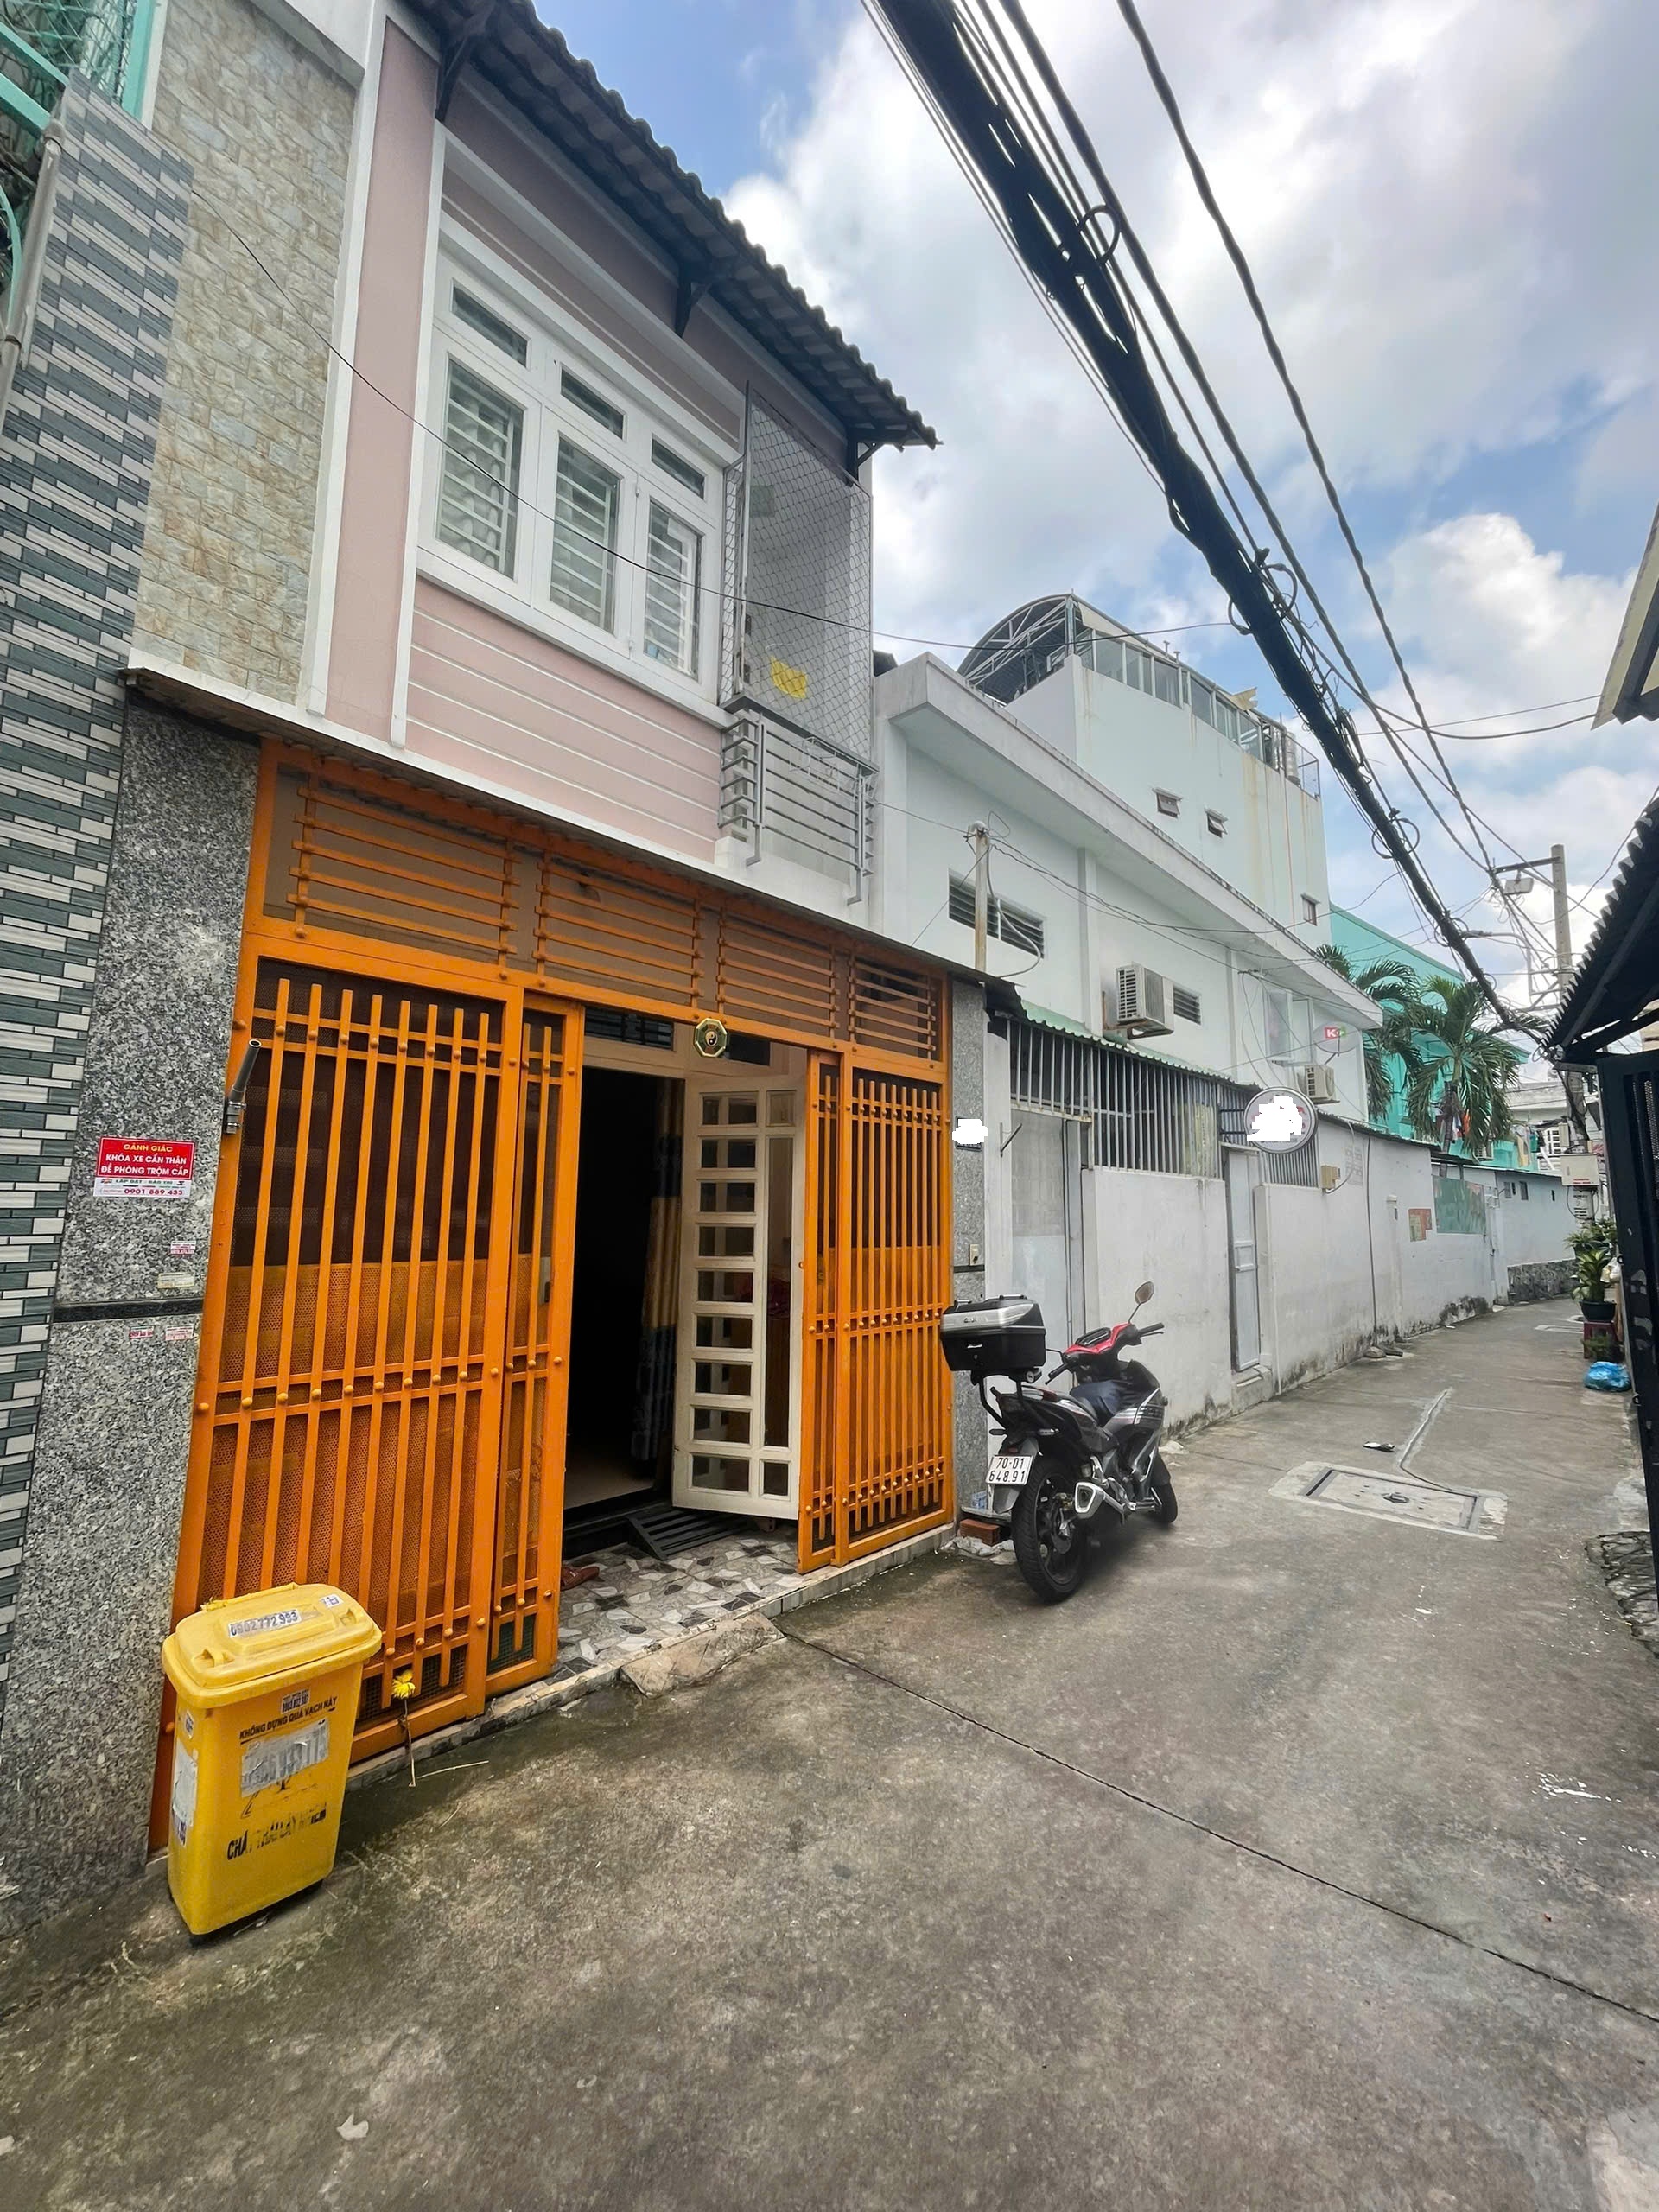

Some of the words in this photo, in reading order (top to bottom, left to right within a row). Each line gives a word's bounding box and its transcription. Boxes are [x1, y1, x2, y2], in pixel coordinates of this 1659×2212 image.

[124, 1142, 149, 1152] CẢNH
[105, 1153, 130, 1162] KHÓA
[165, 1155, 187, 1166] THẬN
[100, 1163, 111, 1173] ĐỀ
[114, 1165, 145, 1174] PHÒNG
[147, 1166, 169, 1176] TRỘM
[988, 1470, 1026, 1483] 648.91
